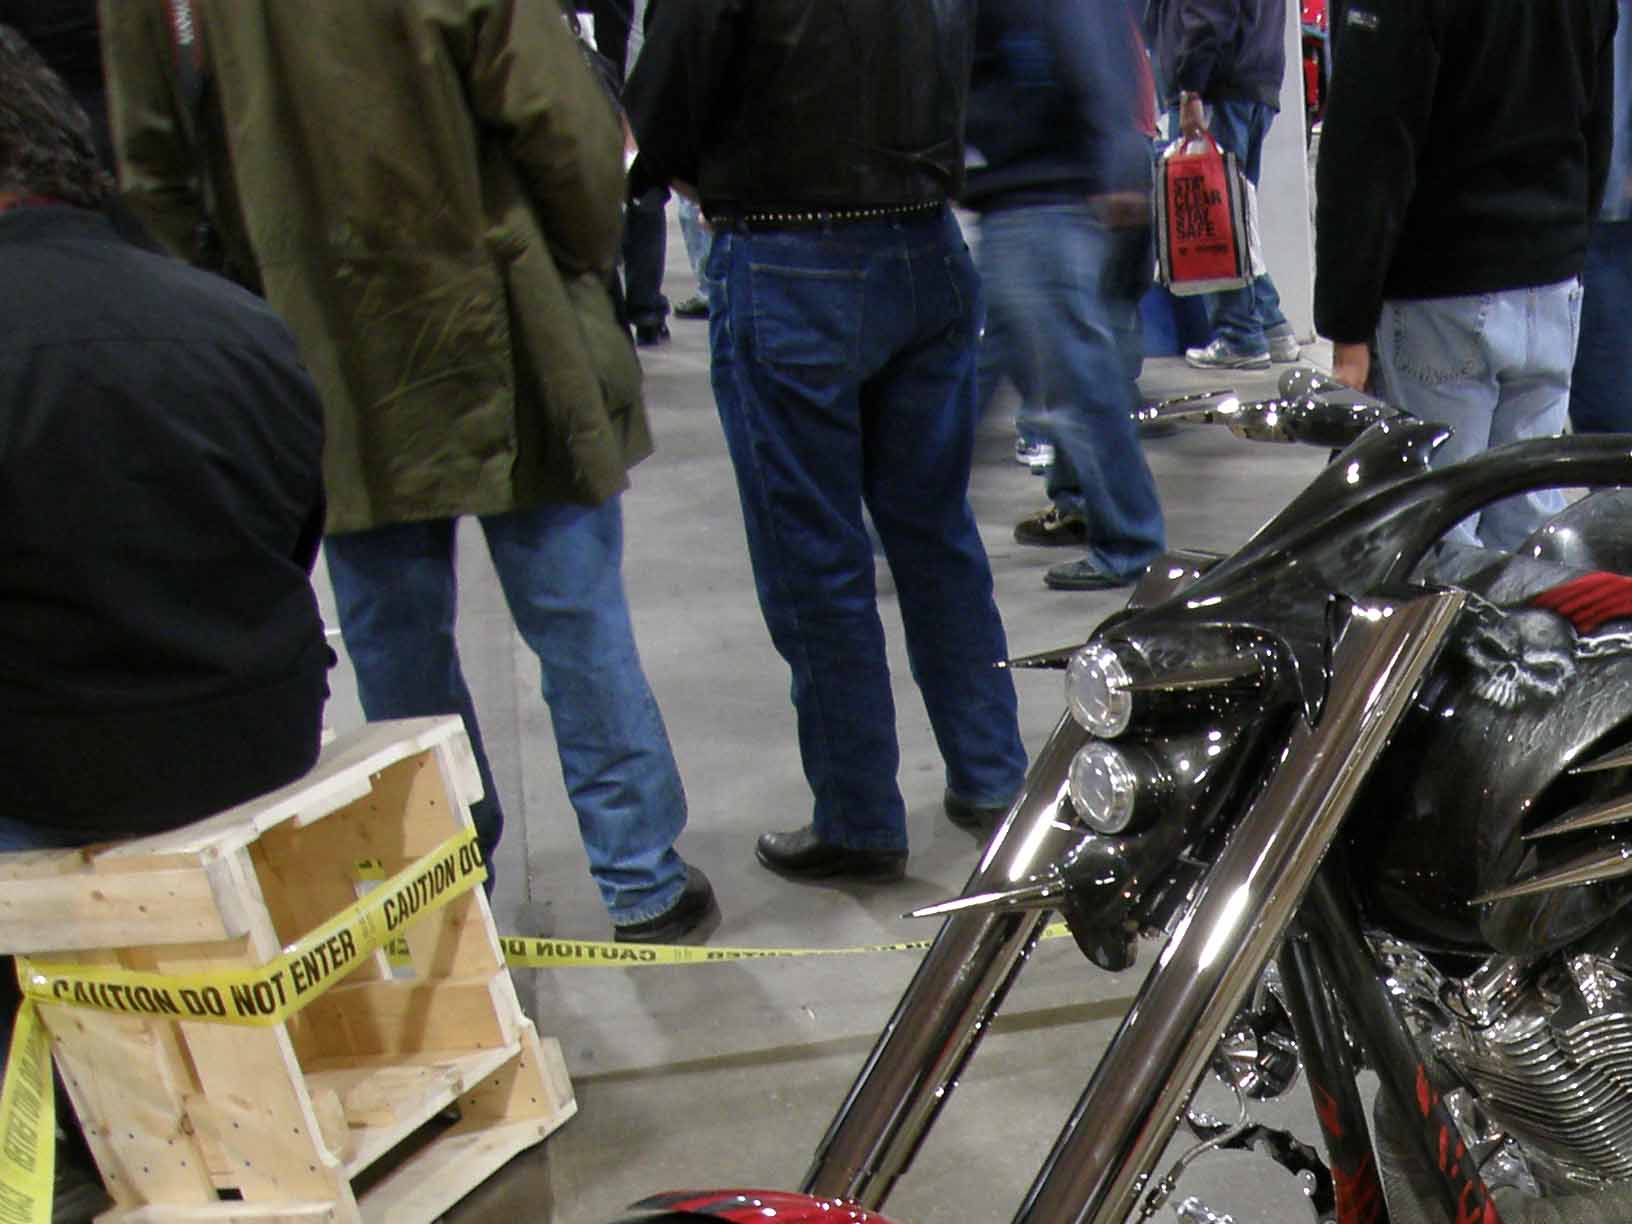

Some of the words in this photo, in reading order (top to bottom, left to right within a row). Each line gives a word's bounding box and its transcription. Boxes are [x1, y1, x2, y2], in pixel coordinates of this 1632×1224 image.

[384, 855, 456, 931] CAUTION
[53, 979, 180, 1015] CAUTION
[179, 986, 227, 1017] DO
[231, 972, 287, 1017] NOT
[288, 928, 356, 996] ENTER
